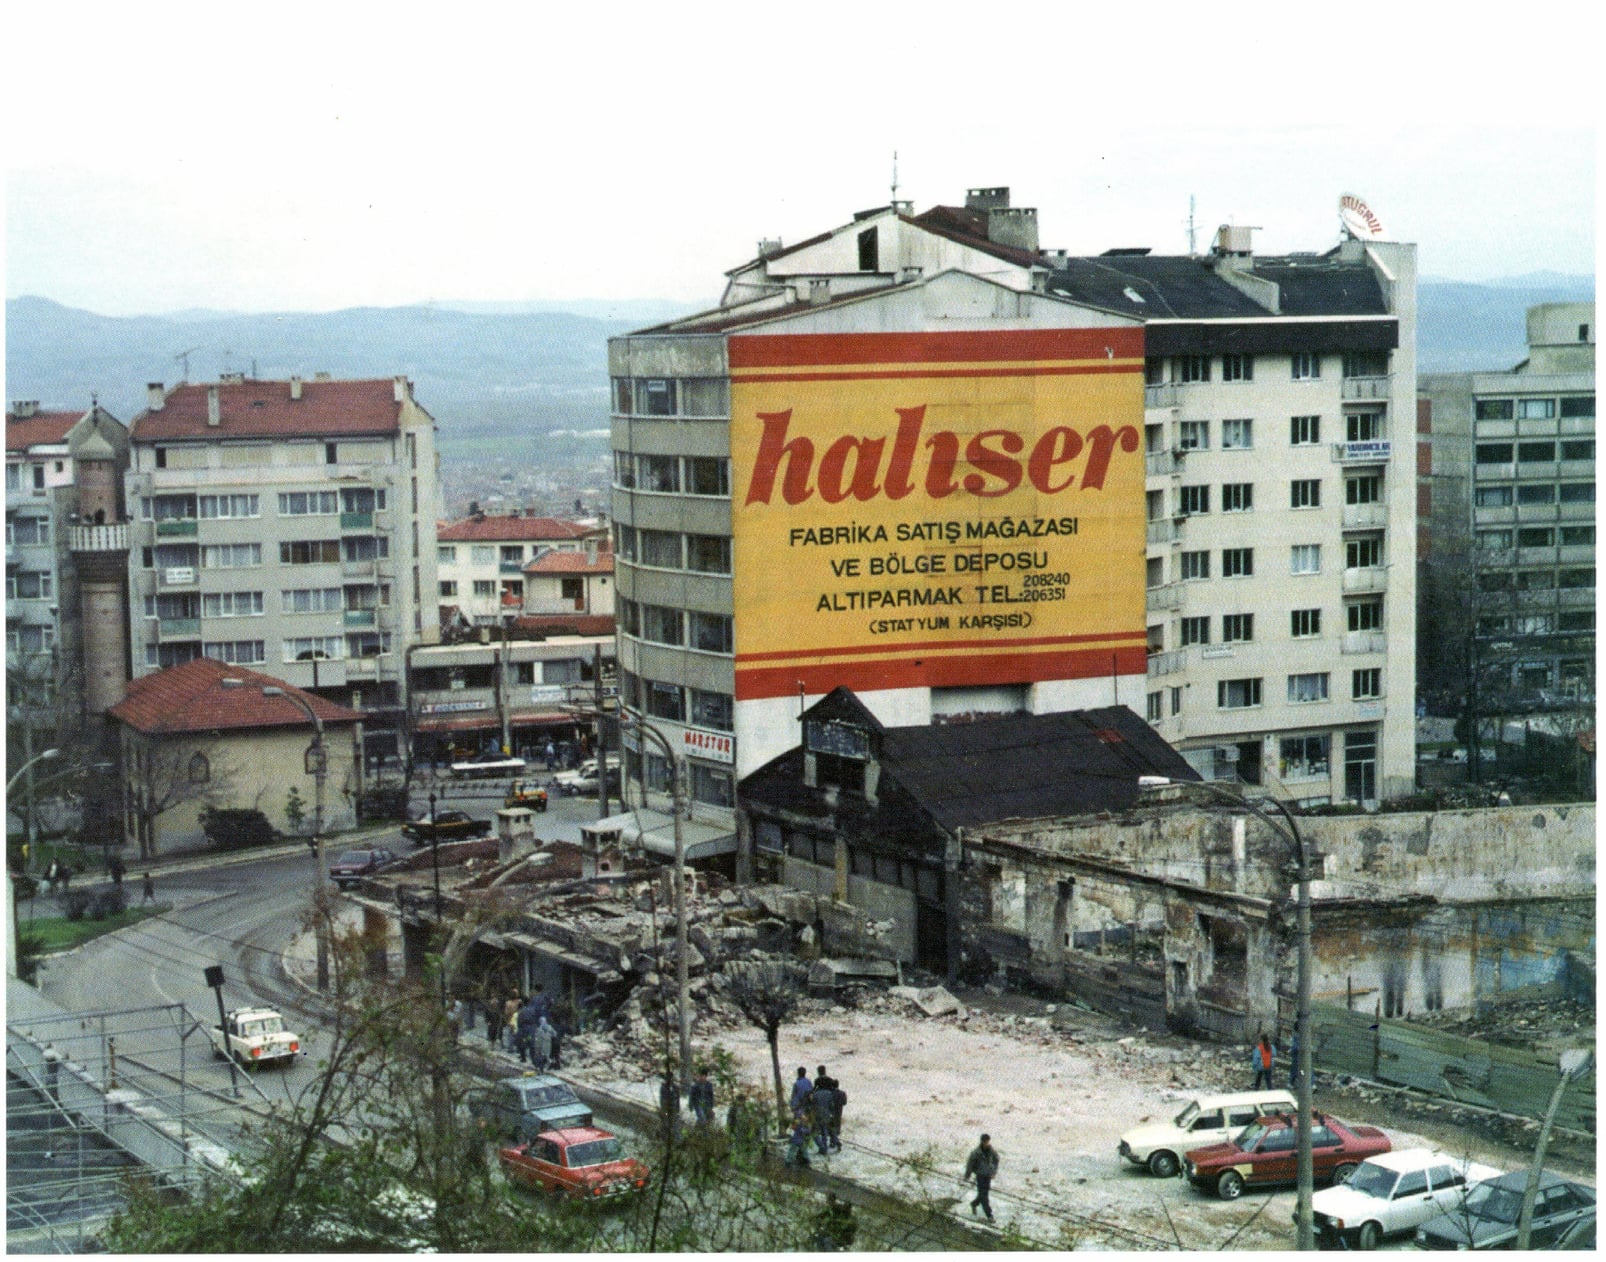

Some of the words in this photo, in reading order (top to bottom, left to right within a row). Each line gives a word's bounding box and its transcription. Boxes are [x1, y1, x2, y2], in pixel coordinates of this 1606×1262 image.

[789, 521, 889, 547] FABRİKA
[896, 522, 961, 544] SATIŞ
[966, 516, 1079, 539] MAĞAZASI
[831, 559, 860, 577] VE
[869, 553, 946, 575] BÖLGE
[954, 552, 1048, 573] DEPOSU
[1023, 572, 1071, 588] 208240
[816, 587, 963, 612] ALTIPARMAK
[1023, 588, 1066, 603] 206351
[959, 611, 1033, 631] KARŞISI)
[684, 731, 730, 754] MARSTUR
